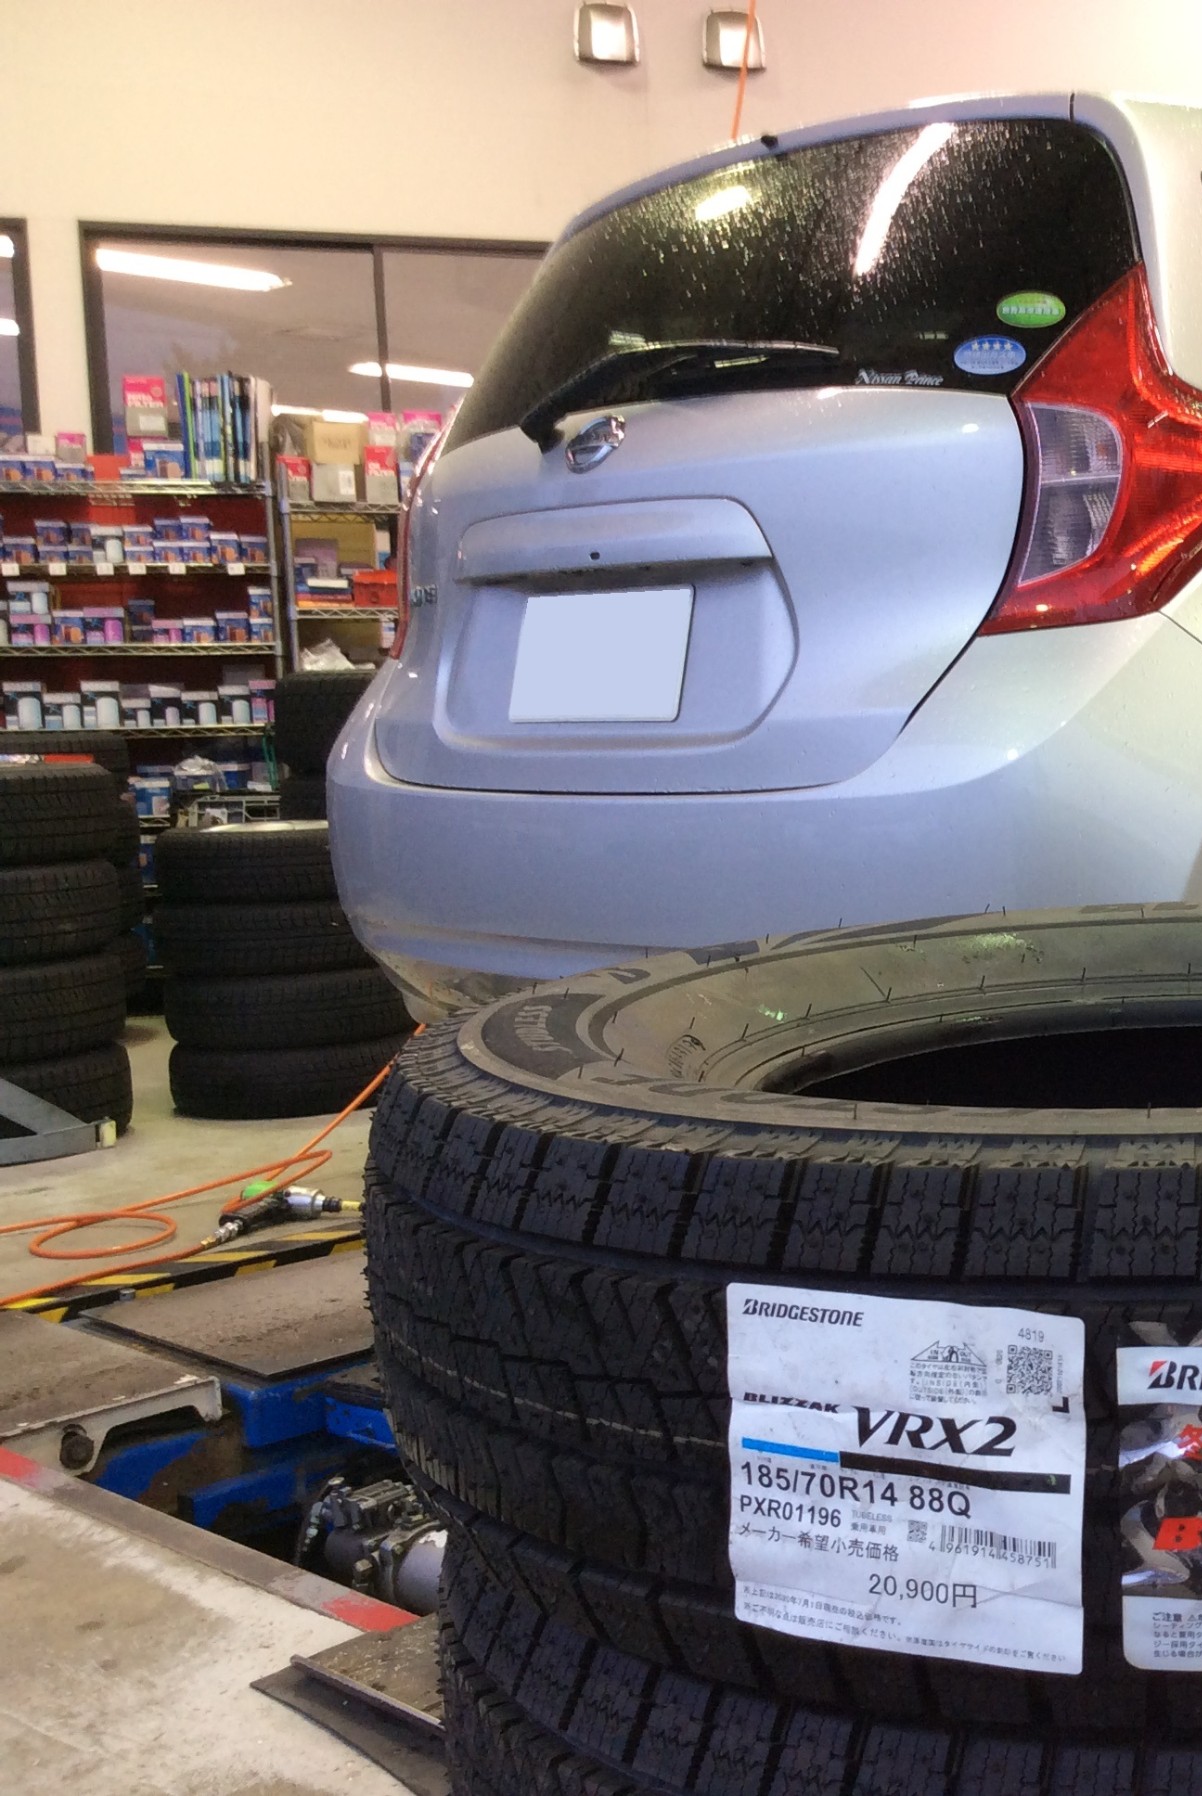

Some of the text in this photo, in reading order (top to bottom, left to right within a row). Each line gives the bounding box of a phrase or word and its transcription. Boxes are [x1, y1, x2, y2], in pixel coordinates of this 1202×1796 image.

[742, 1299, 864, 1327] BRIDGESTONE
[1017, 1327, 1045, 1343] 4819
[743, 1391, 839, 1415] BLIZZAK
[853, 1406, 1018, 1457] VRX2
[740, 1462, 971, 1519] 185/70R14 88Q
[739, 1495, 842, 1528] PXR01196
[739, 1524, 899, 1562] メーカー希望小売価格
[868, 1573, 978, 1609] 20,900円
